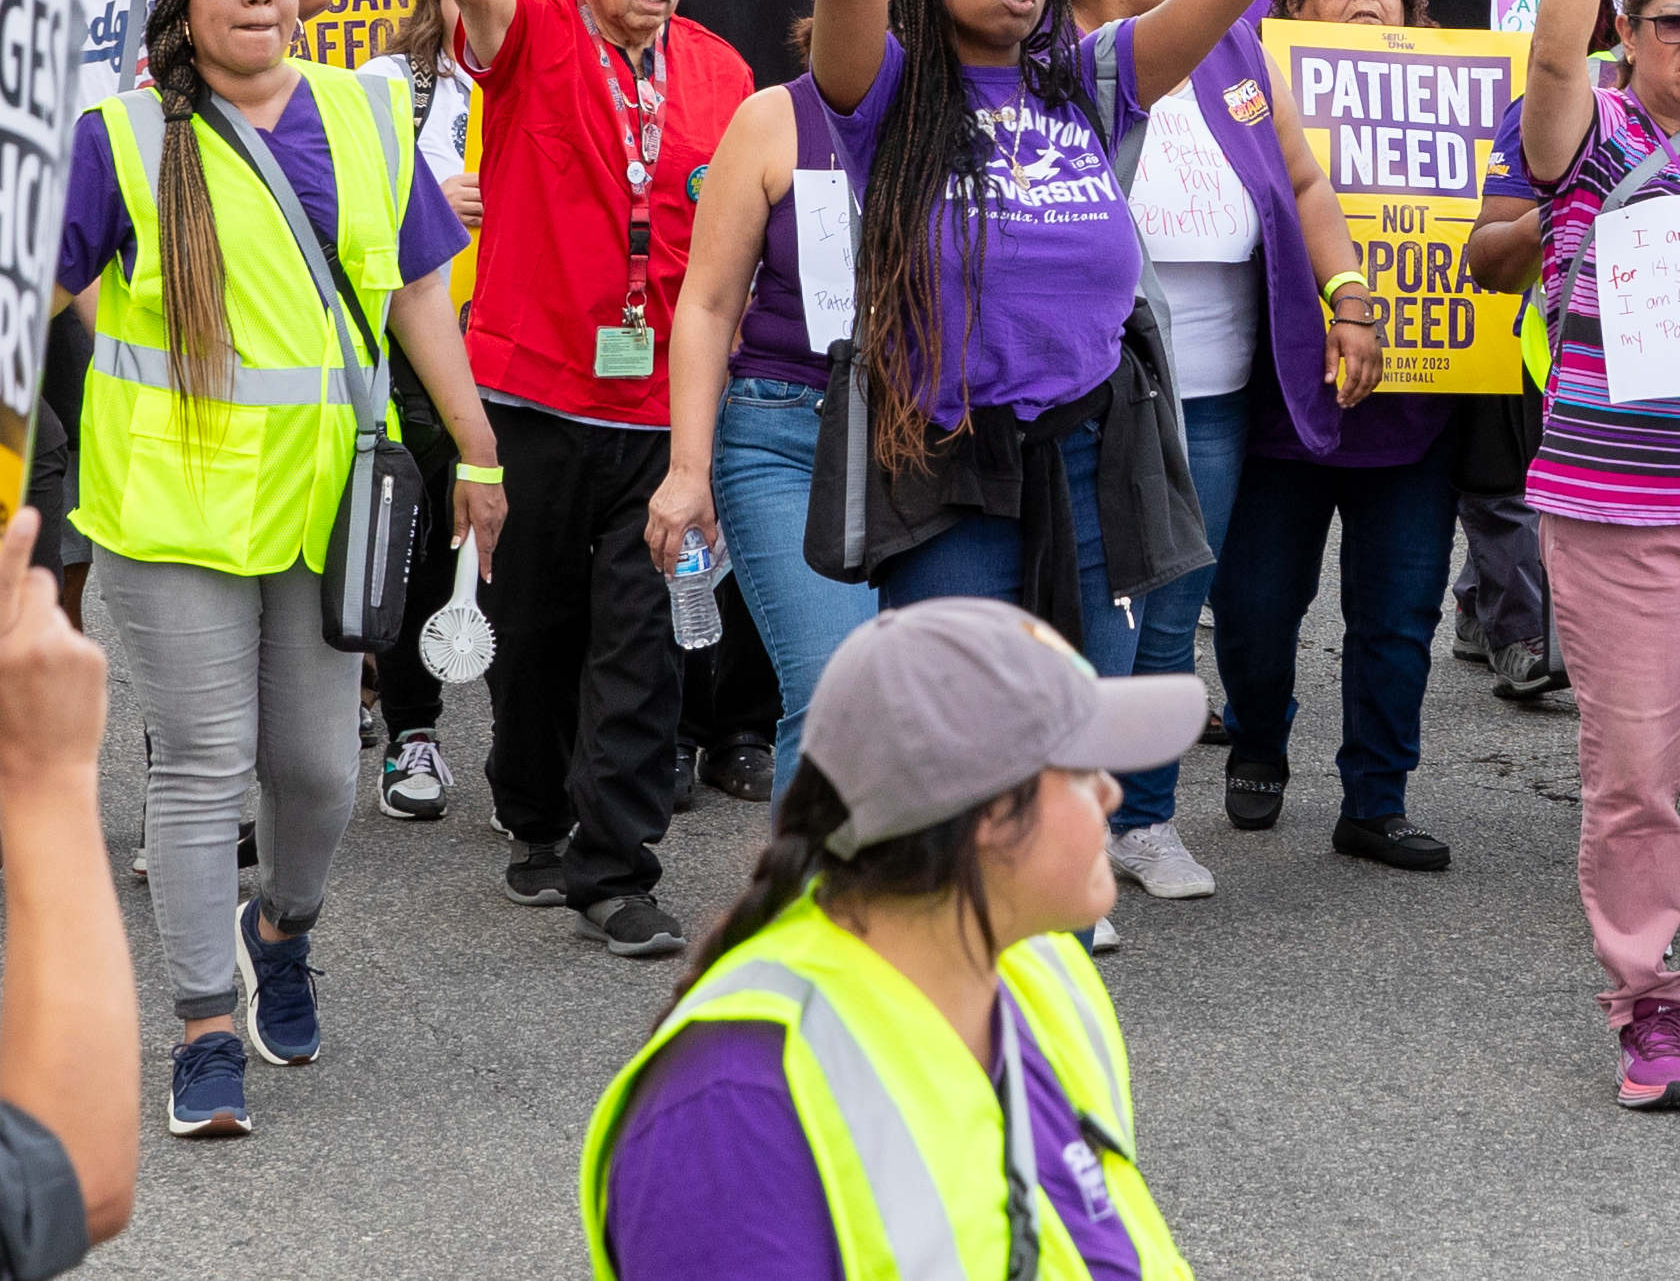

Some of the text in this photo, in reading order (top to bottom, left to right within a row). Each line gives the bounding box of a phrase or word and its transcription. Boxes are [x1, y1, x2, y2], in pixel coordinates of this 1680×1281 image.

[1301, 59, 1503, 128] PATIENT
[1001, 110, 1090, 149] CANYON
[1072, 154, 1100, 168] 1949
[1339, 125, 1469, 191] NEED
[1044, 209, 1109, 222] Arizona
[1382, 205, 1429, 234] NOT
[1633, 230, 1649, 248] I
[1608, 265, 1637, 289] for
[1652, 257, 1669, 276] 14
[1618, 295, 1633, 315] I
[1646, 296, 1670, 310] am
[1621, 331, 1642, 353] my
